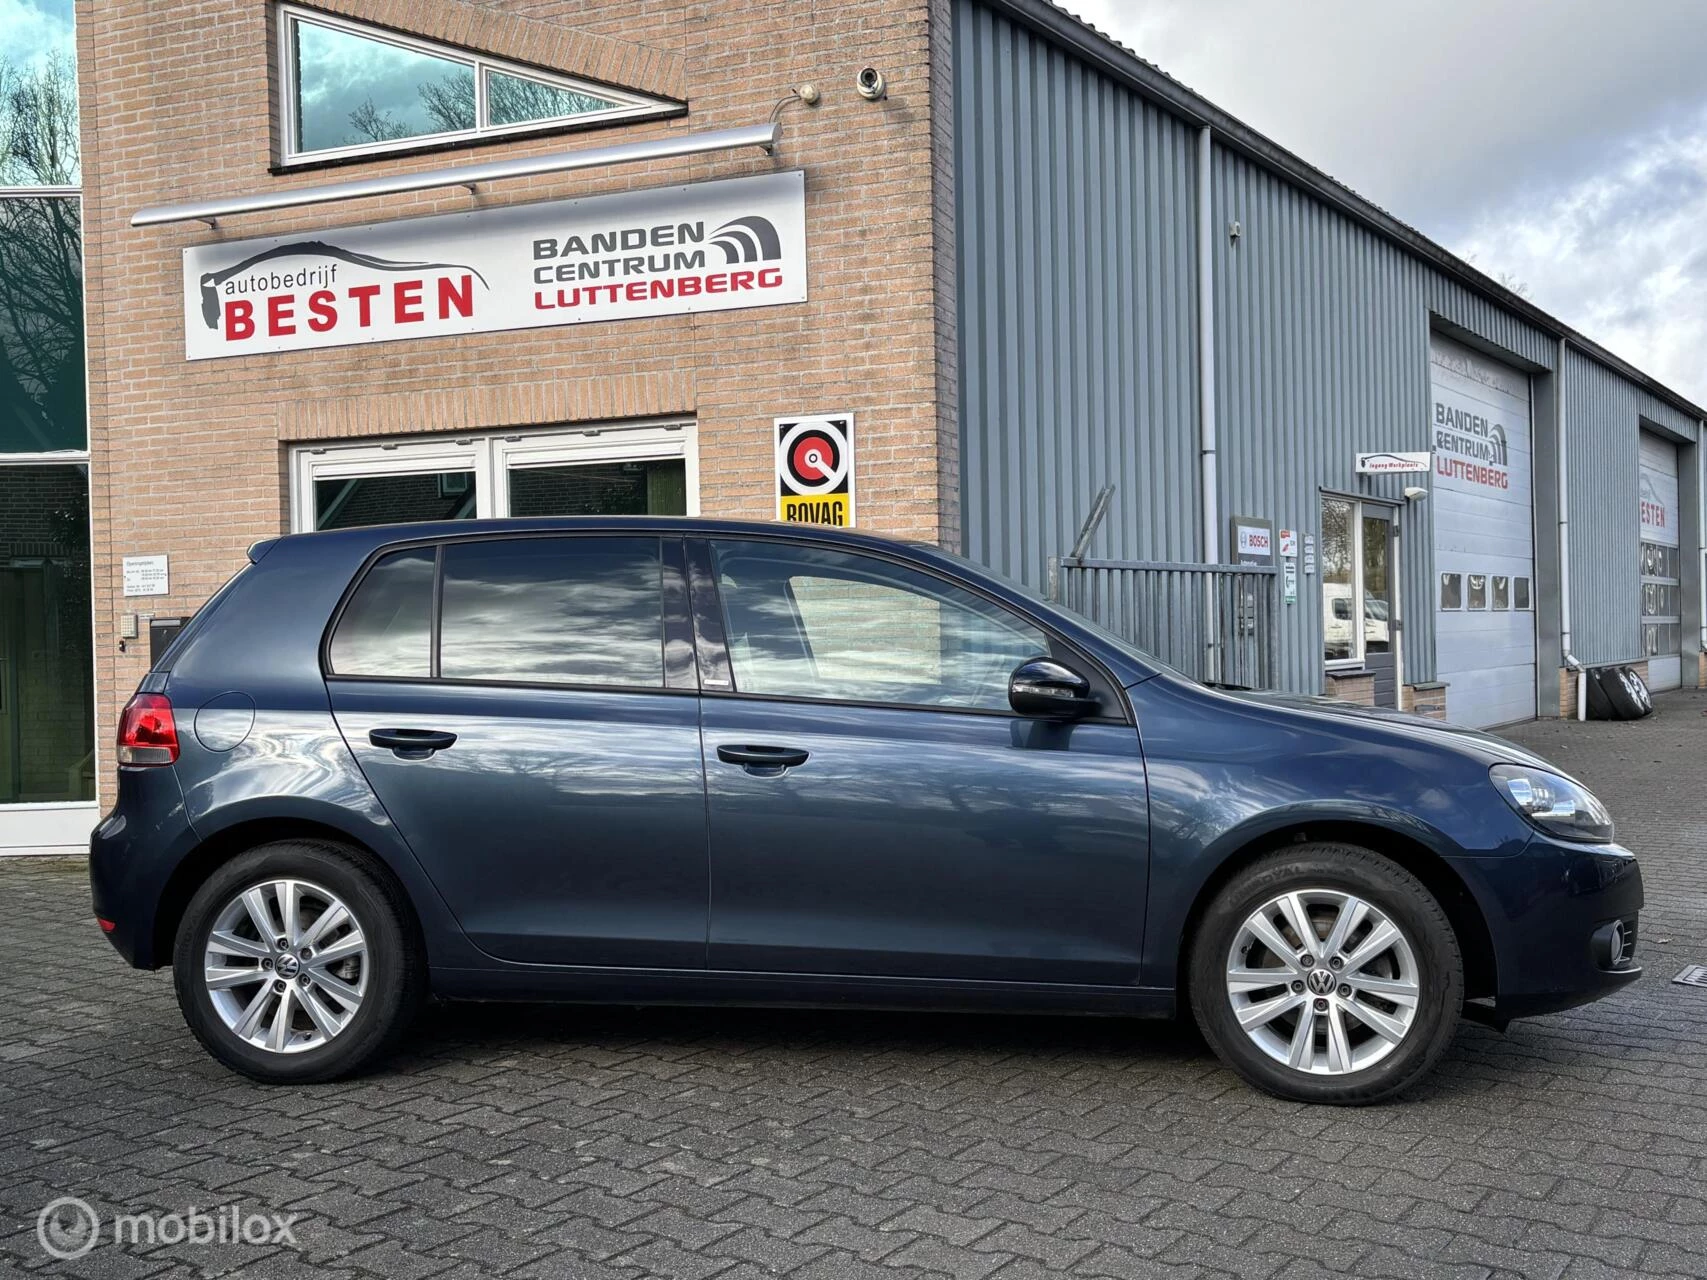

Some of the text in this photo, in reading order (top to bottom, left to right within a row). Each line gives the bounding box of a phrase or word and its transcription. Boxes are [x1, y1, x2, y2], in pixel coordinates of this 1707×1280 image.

[533, 221, 705, 260] BANDEN
[225, 263, 338, 294] autobedrijf
[533, 250, 706, 284] CENTRUM
[534, 267, 783, 310] LUTTENBERG
[225, 274, 473, 341] BESTEN
[1435, 402, 1488, 438] BANDEN
[1436, 430, 1489, 462] CENTRUM
[1437, 455, 1508, 490] LUTTENBERG
[786, 501, 843, 527] ROVAG
[1641, 501, 1665, 528] ESTEN
[1249, 534, 1269, 548] BOSCH
